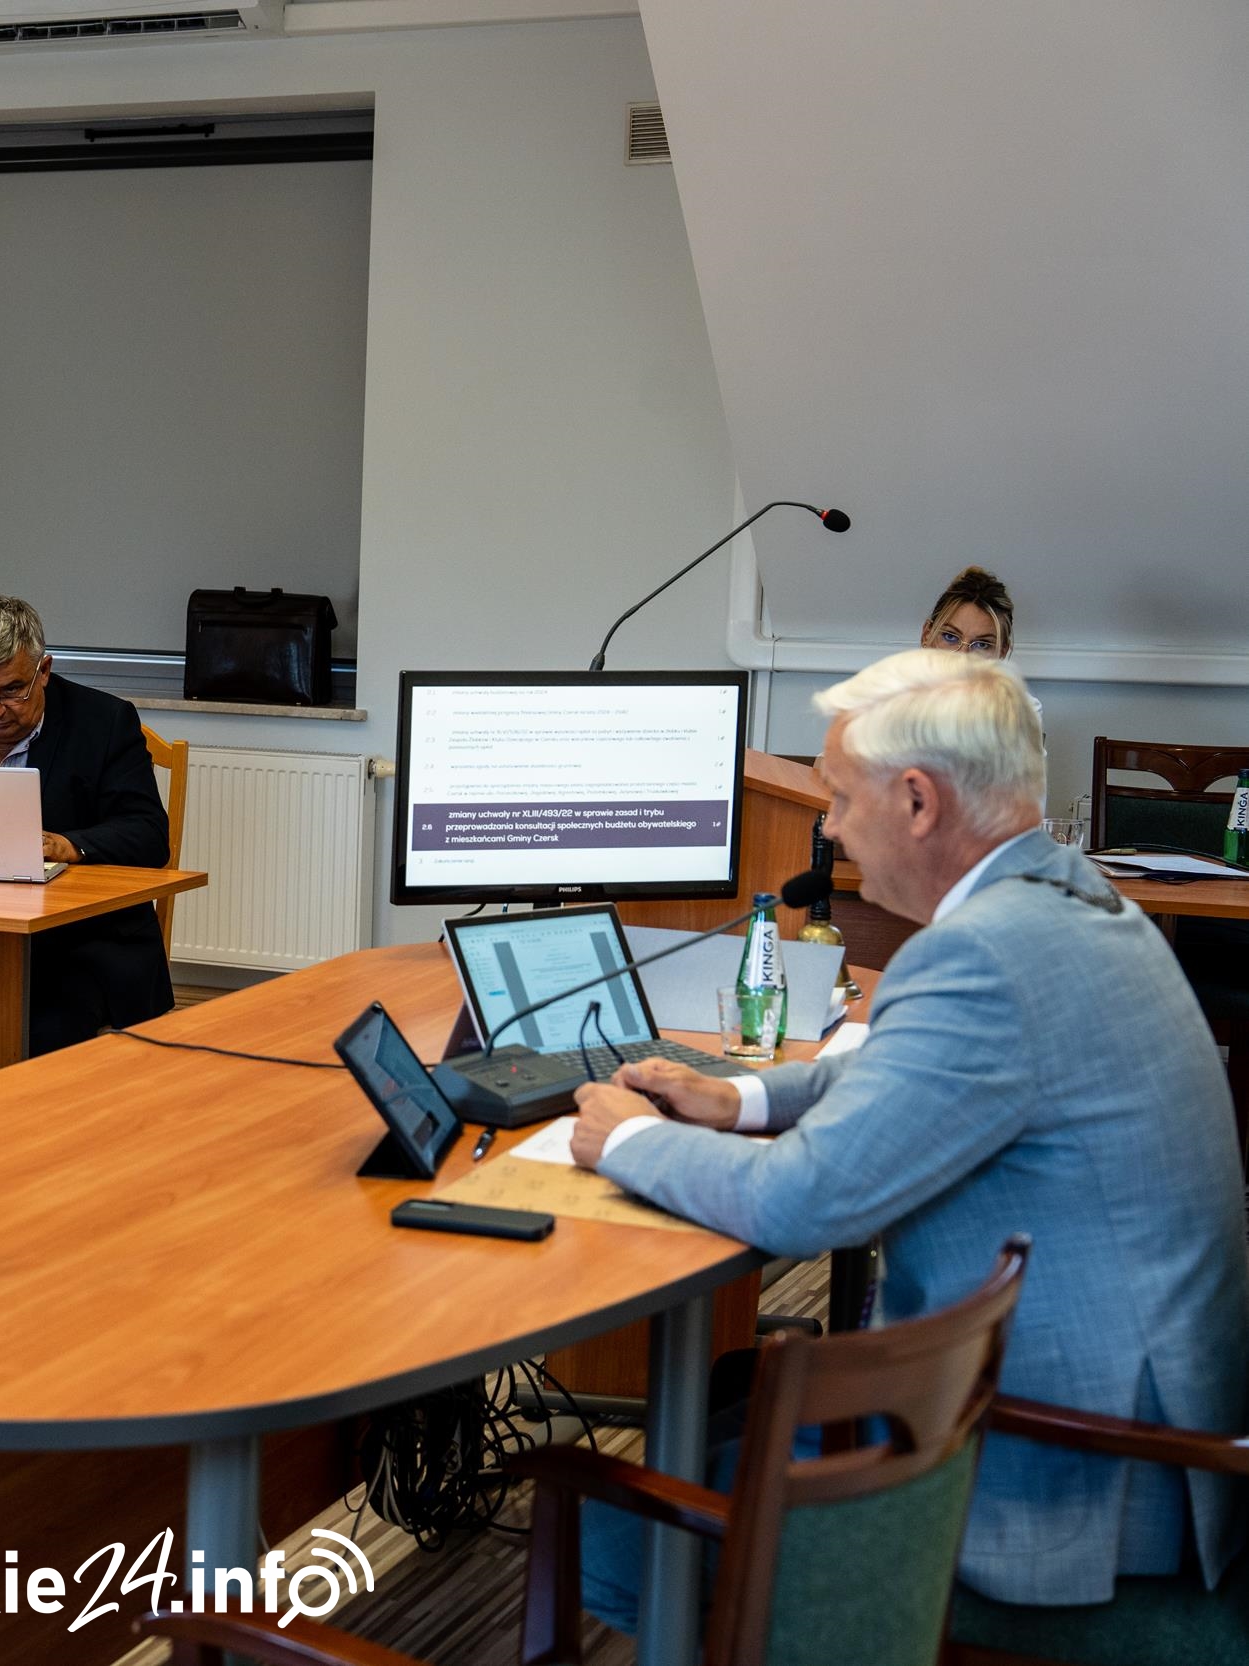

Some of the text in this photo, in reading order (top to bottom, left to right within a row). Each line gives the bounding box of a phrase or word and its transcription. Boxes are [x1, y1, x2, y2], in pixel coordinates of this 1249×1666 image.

[448, 810, 476, 820] zmiany
[478, 809, 510, 820] uchwały
[583, 809, 614, 819] sprawie
[615, 808, 638, 816] zasad
[643, 808, 665, 818] trybu
[1236, 792, 1249, 827] KINGA
[445, 819, 697, 832] przeprowadzania konsultacji społecznych budżetu obywatelskiego
[445, 833, 559, 844] z mieszkańcami Gminy Czersk
[763, 930, 774, 983] KINGA
